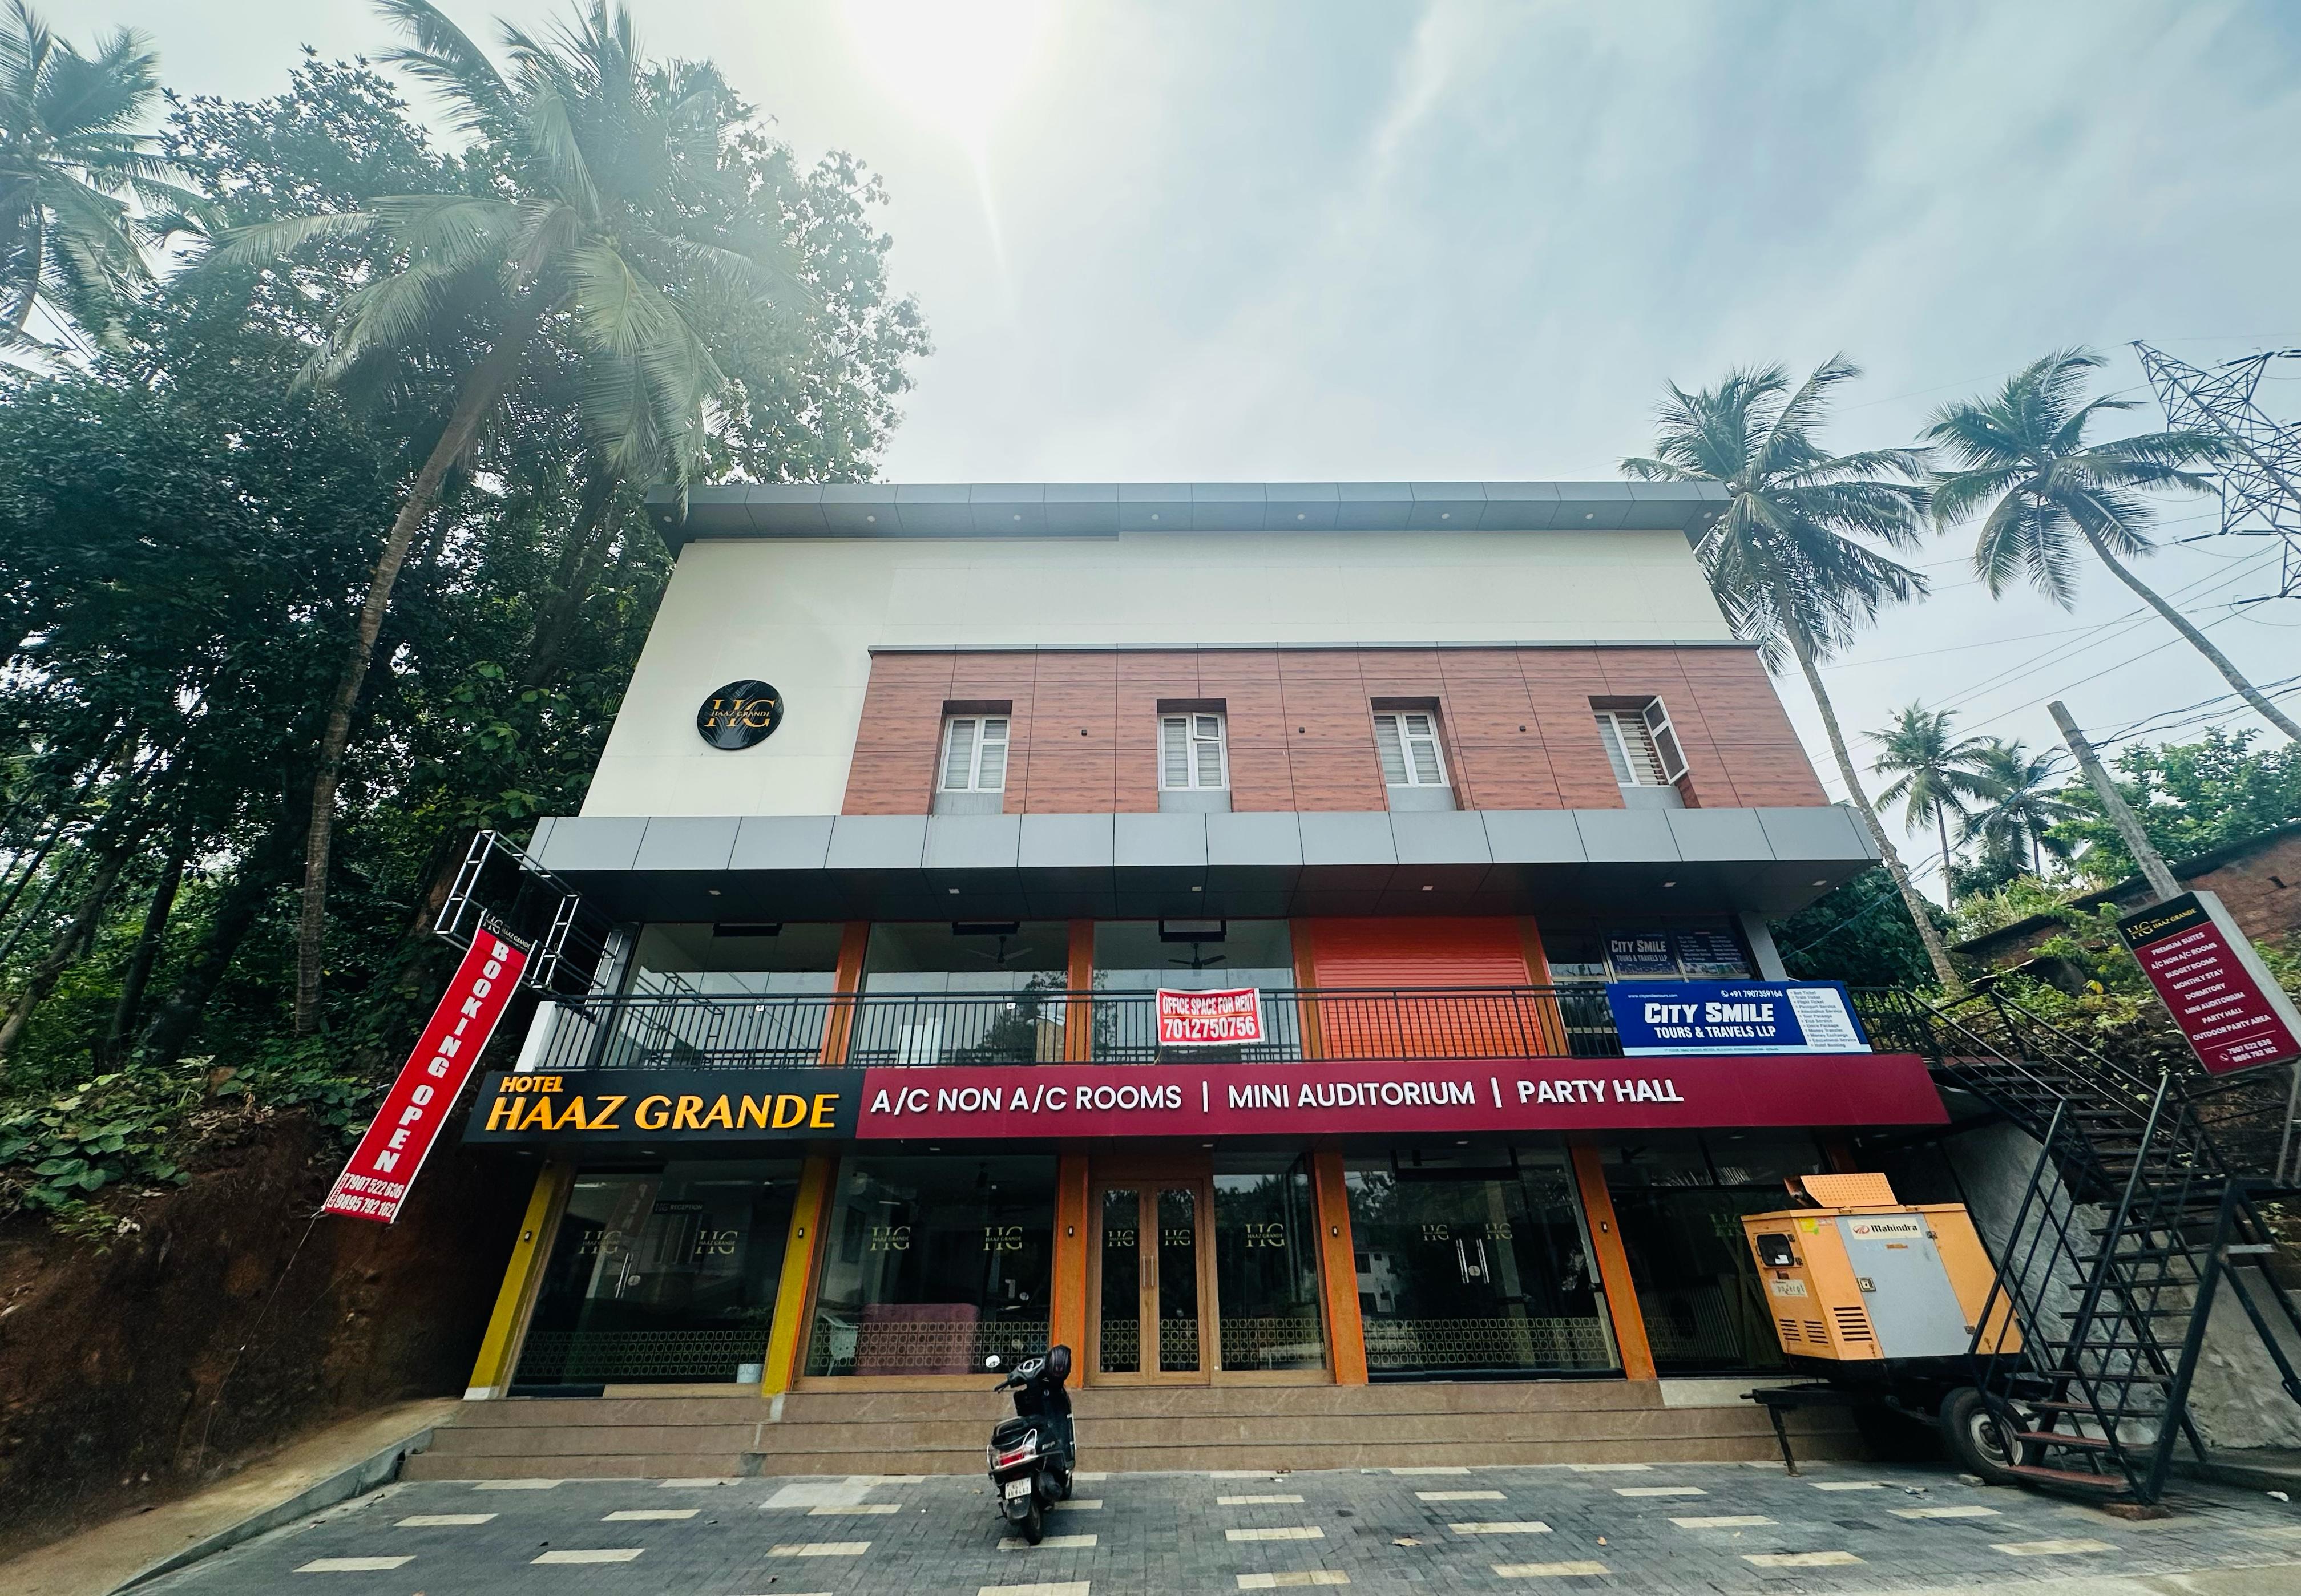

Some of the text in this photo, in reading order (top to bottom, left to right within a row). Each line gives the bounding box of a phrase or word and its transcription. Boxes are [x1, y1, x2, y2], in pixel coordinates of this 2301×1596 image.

[2170, 908, 2197, 922] GRANDE
[1611, 940, 1667, 953] CITY SMILE
[2151, 932, 2205, 956] PREMIUM SUITES
[2151, 942, 2218, 969] A/C NON A/C ROOMS
[2165, 957, 2218, 979] BUDGET ROOMS
[2173, 968, 2224, 990] MONTHLY STAY
[1744, 989, 1783, 998] 7907359164
[2185, 983, 2226, 1000] DORMITORY
[1162, 993, 1254, 1015] OFFICE SPACE FOR RENT
[1644, 1002, 1774, 1024] CITY SMILE
[2184, 992, 2246, 1015] MINI AUDITORIUM
[2201, 1007, 2244, 1024] PARTY HALL
[1164, 1016, 1256, 1039] 7012750756
[1654, 1025, 1776, 1039] TOURS & TRAVELS LLP
[2193, 1015, 2272, 1041] OUTDOOR PARTY AREA
[373, 940, 510, 1173] BOOKING OPEN
[500, 1076, 563, 1093] HOTEL
[870, 1078, 1685, 1116] A/C NON A/C ROOMS MINI AUDITORIUM PARTY HALL
[485, 1094, 840, 1131] HAAZ GRANDE
[344, 1174, 405, 1199] 7907 522 636
[334, 1193, 396, 1217] 9895 792 162
[1871, 1224, 1918, 1233] Mahindra
